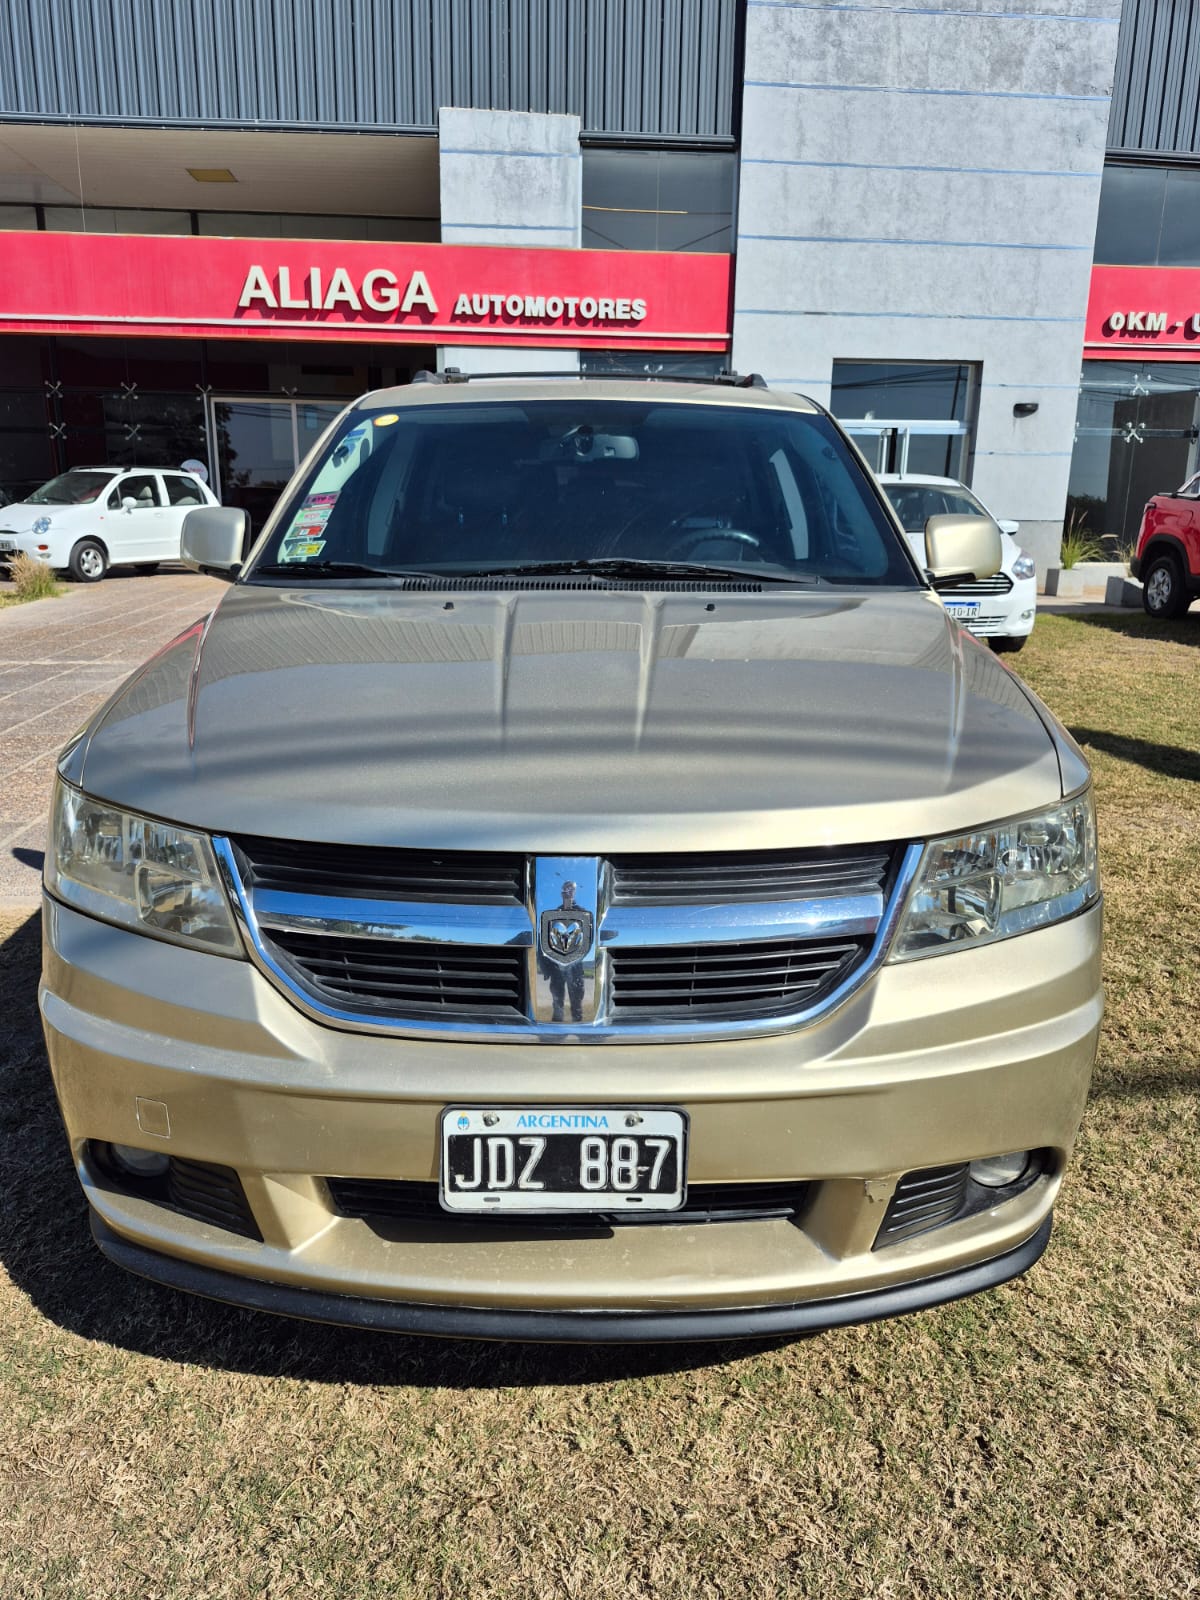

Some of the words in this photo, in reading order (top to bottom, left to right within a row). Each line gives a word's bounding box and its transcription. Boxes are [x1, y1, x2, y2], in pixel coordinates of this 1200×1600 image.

[238, 265, 439, 313] ALIAGA
[454, 294, 647, 320] AUTOMOTORES
[516, 1114, 609, 1129] ARGENTINA
[454, 1137, 547, 1190] JDZ
[579, 1136, 671, 1191] 887
